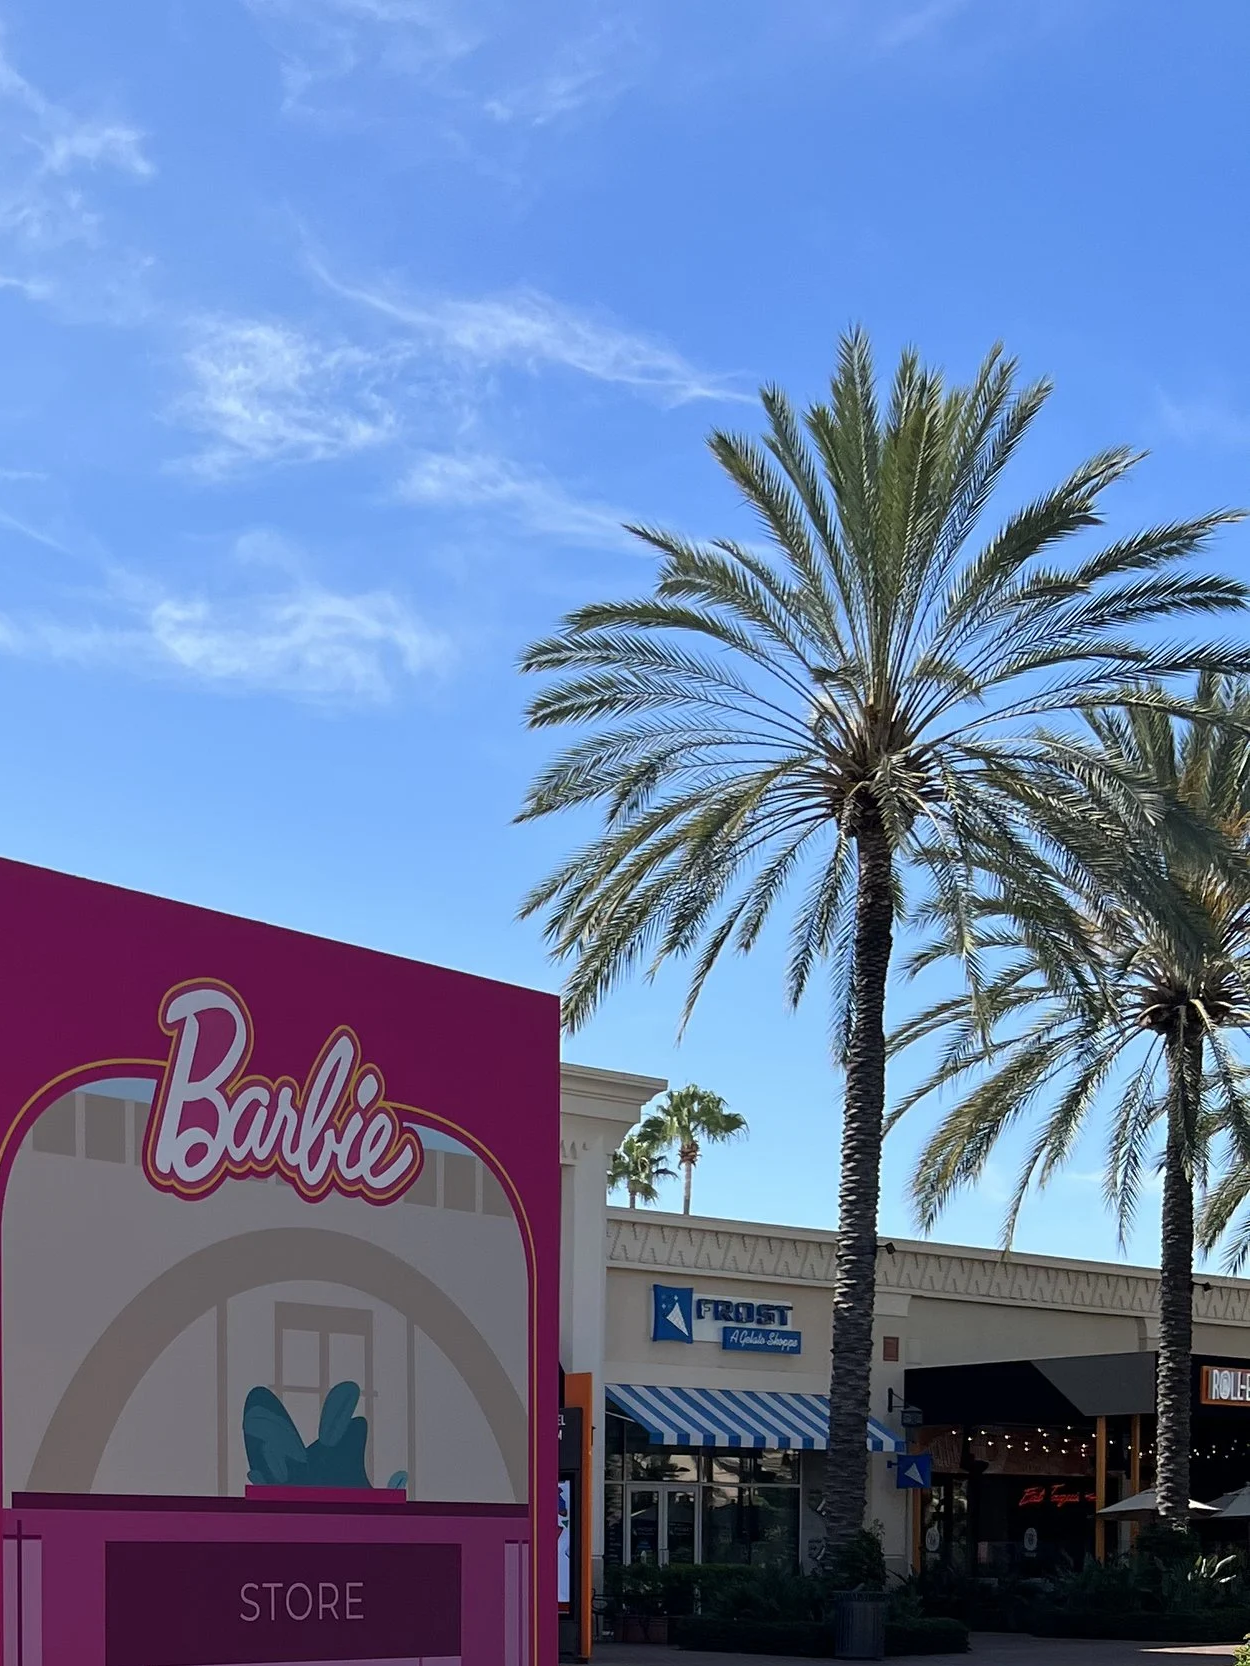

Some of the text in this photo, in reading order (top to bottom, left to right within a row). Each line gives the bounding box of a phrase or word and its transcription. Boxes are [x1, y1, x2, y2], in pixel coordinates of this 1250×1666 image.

[156, 989, 413, 1189] Barbie
[697, 1299, 793, 1326] FROST
[730, 1330, 798, 1350] A Gelato Shoppe
[240, 1582, 364, 1622] STORE
